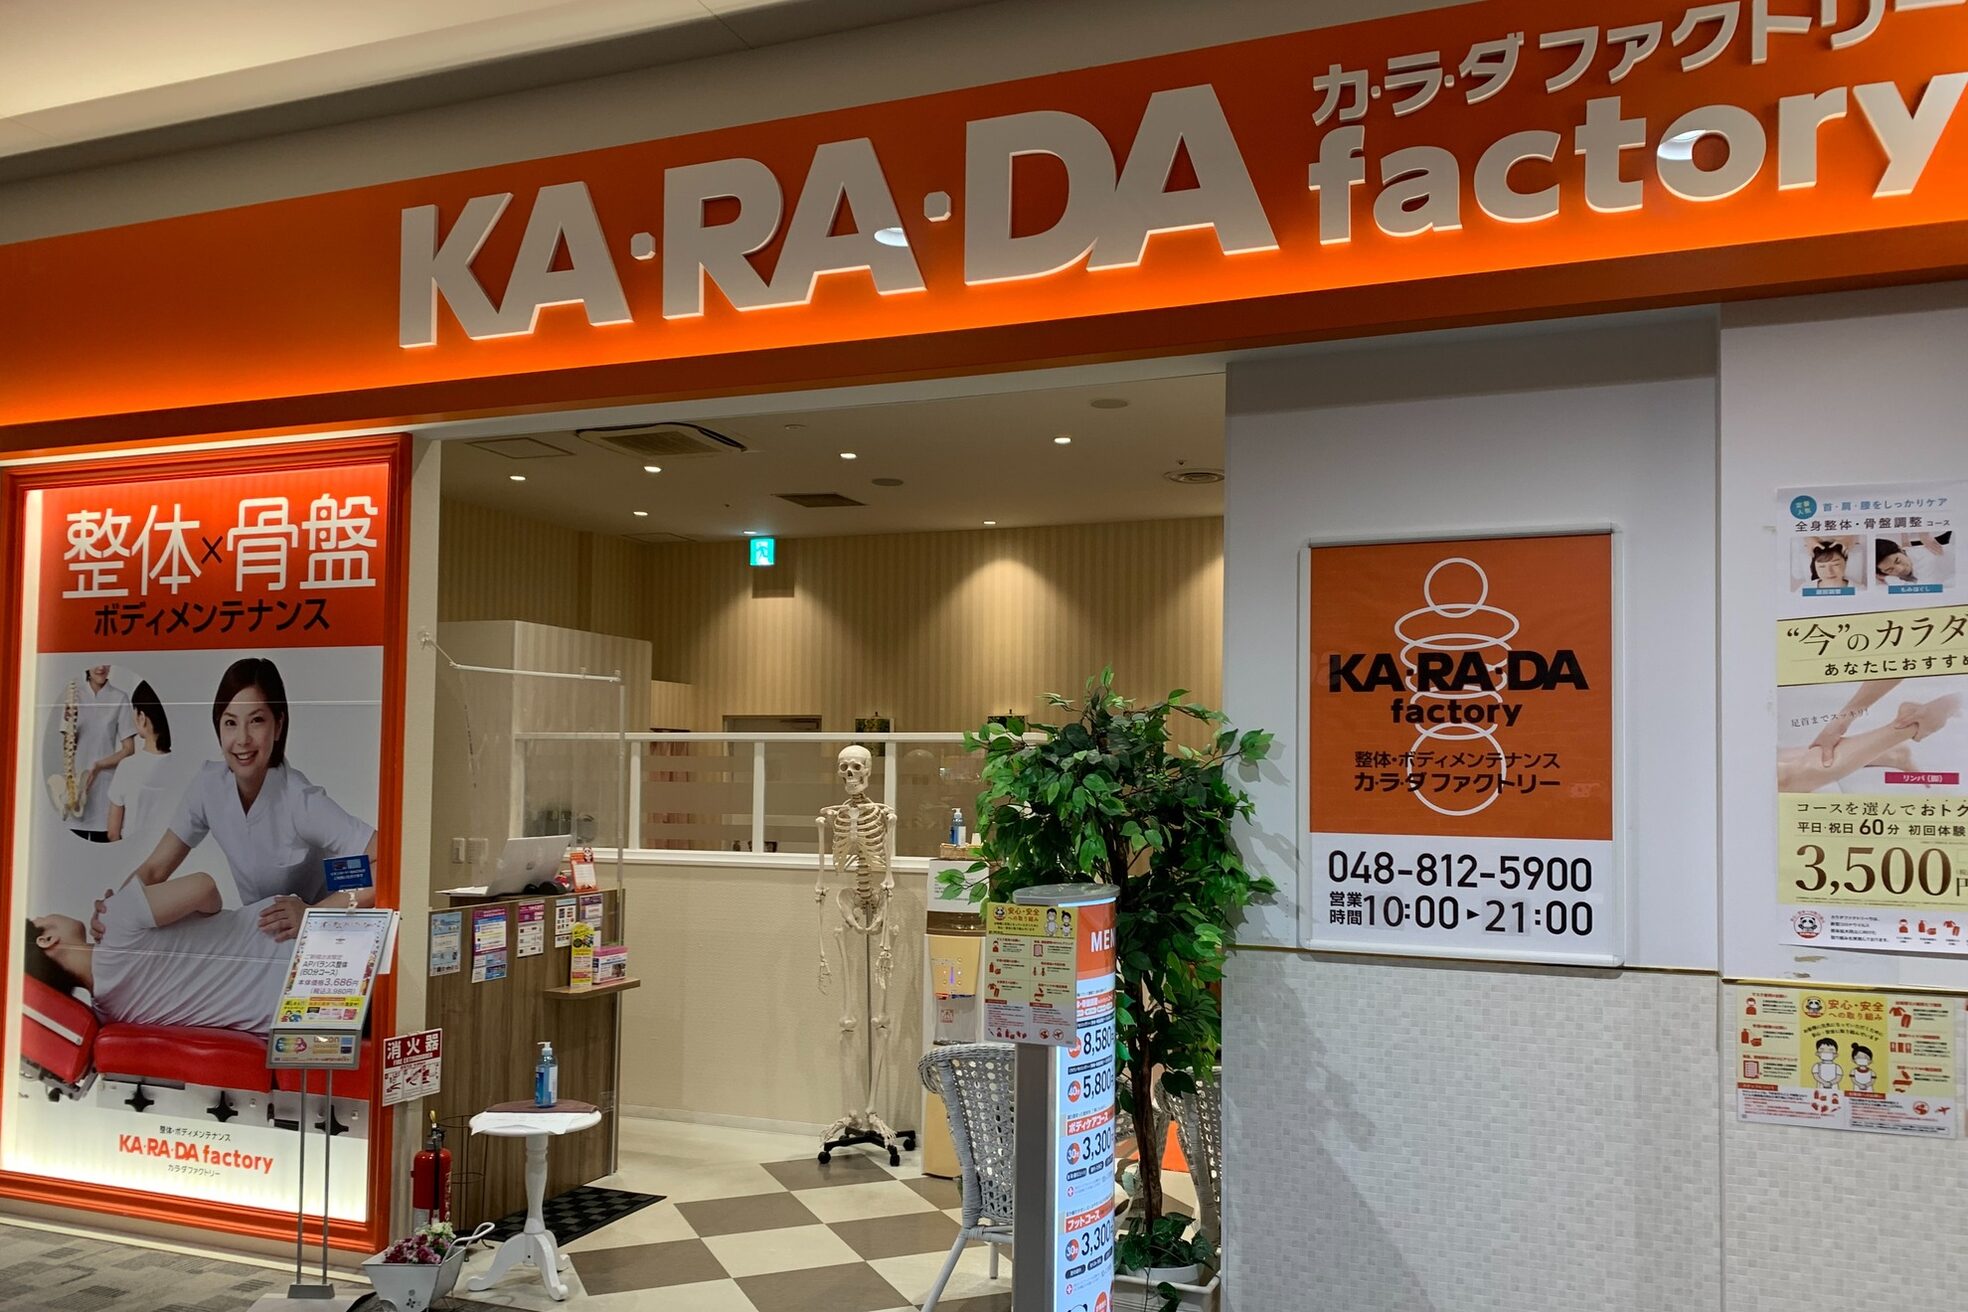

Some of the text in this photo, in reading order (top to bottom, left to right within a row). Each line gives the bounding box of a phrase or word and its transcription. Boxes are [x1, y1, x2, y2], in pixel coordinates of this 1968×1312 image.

[1308, 72, 1968, 245] factory
[94, 598, 331, 637] ボディメンテナンス
[1390, 698, 1523, 727] factory
[1354, 750, 1561, 770] 整体・ボディメンテナンス
[1328, 849, 1593, 893] 048-812-5900
[1363, 893, 1593, 936] 10:00 21:00
[1827, 998, 1885, 1013] 安心・安全
[1828, 1012, 1883, 1022] への取り組み
[387, 1033, 440, 1060] 消火器
[160, 1125, 232, 1142] 整体・ボディメンテナンス
[203, 1145, 274, 1174] factory
